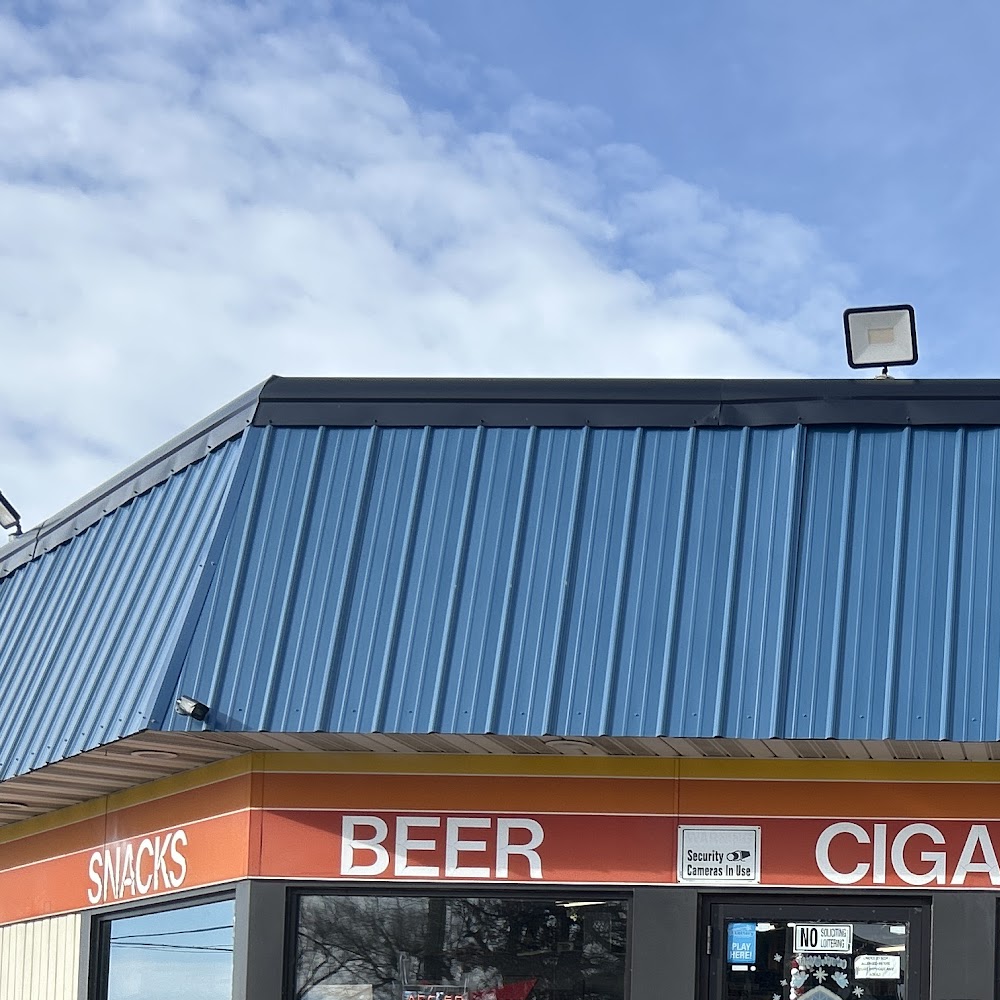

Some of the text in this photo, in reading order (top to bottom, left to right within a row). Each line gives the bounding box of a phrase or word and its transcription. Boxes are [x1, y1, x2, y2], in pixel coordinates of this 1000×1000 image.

[340, 815, 544, 879] BEER
[687, 850, 724, 864] Security
[87, 830, 188, 904] SNACKS
[687, 864, 751, 876] Cameras In Use
[800, 928, 847, 947] NO SOLICITING
[732, 942, 751, 950] PLAY
[730, 951, 752, 960] HERE!
